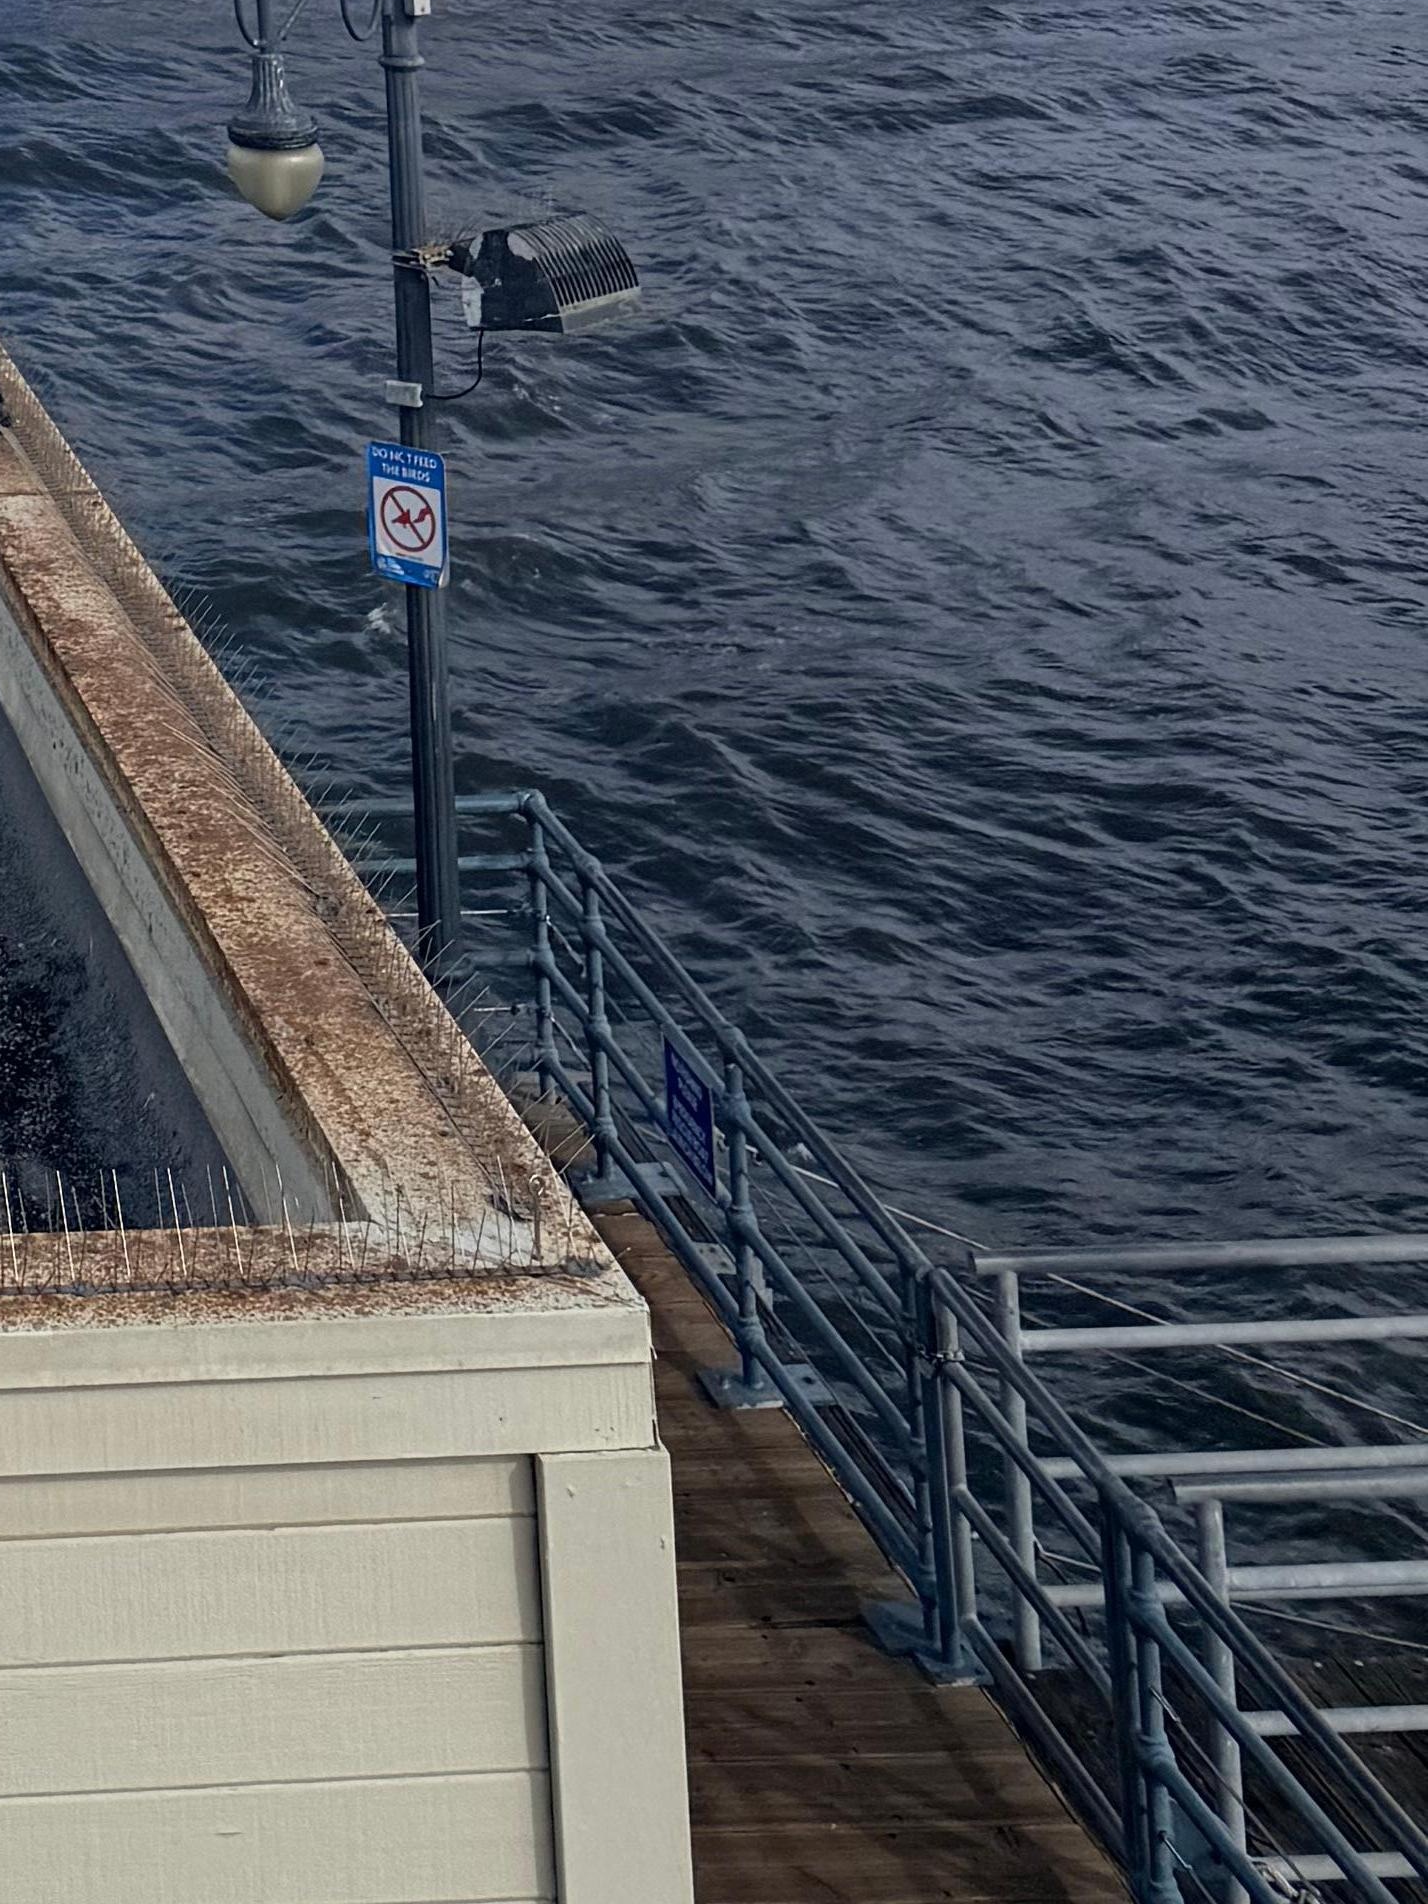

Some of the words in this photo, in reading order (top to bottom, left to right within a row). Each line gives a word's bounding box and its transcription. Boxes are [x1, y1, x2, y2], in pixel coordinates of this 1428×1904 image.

[371, 446, 388, 459] DO
[390, 450, 412, 465] NOT
[413, 455, 437, 469] FEED
[382, 462, 400, 476] THE
[401, 466, 431, 482] BIRDS
